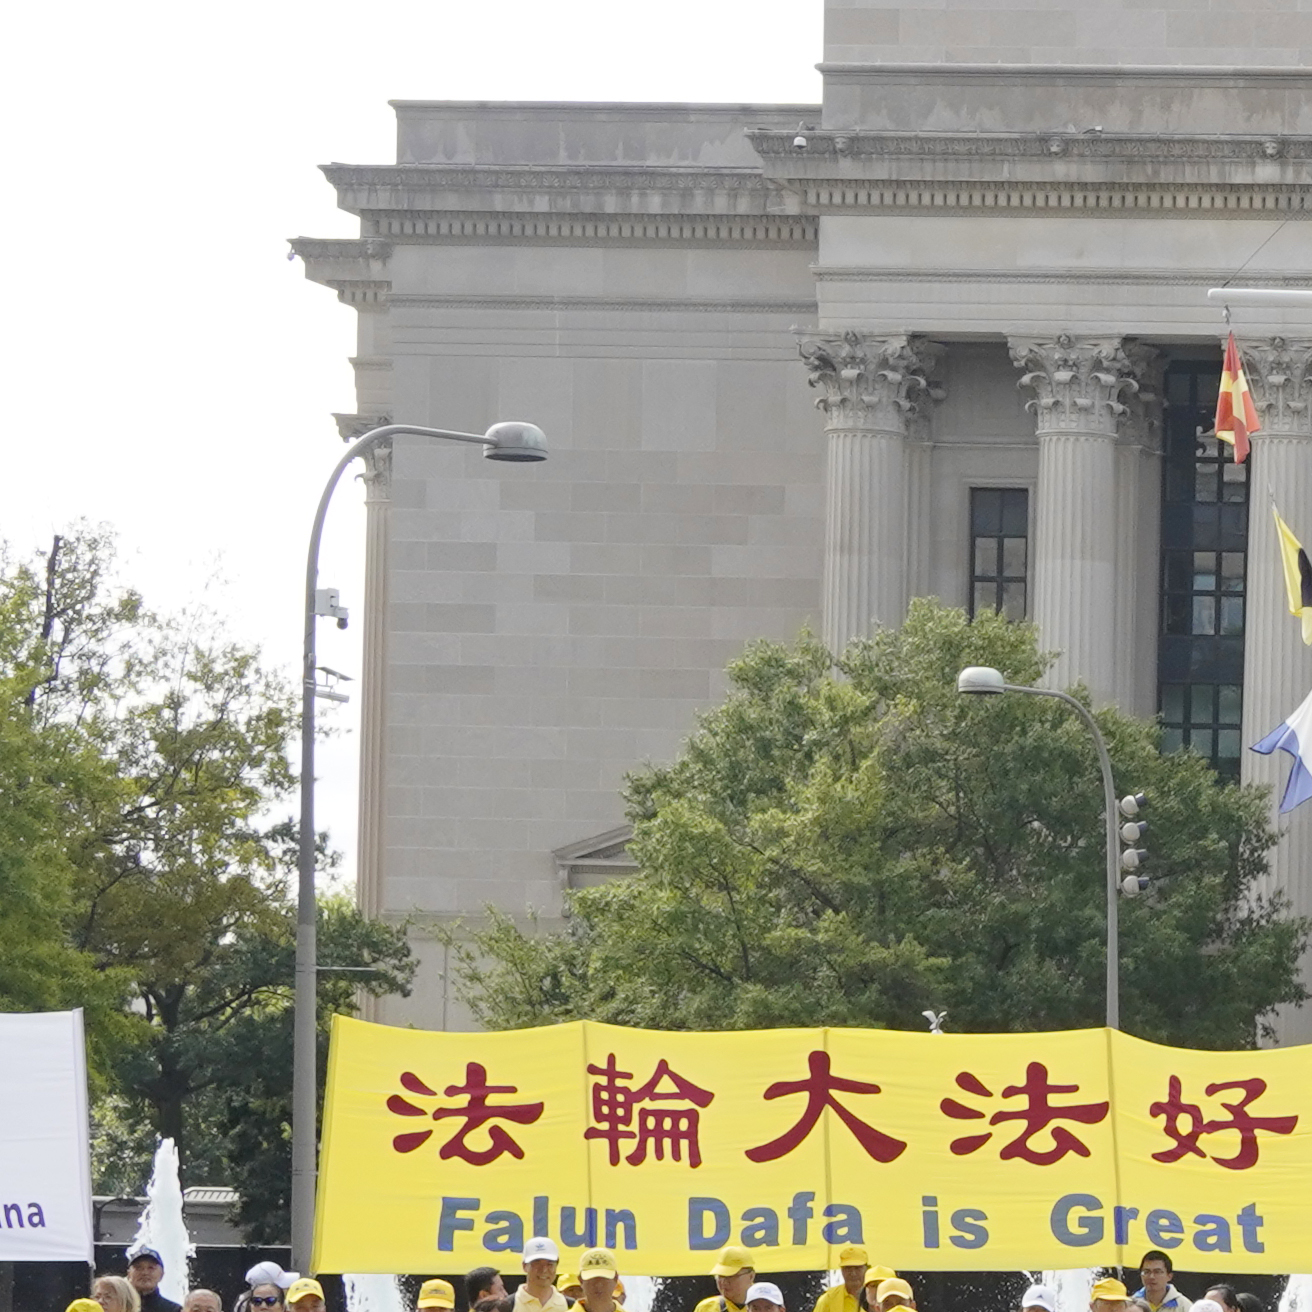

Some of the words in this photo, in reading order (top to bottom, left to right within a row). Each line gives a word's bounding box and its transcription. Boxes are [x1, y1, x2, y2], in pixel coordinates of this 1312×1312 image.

[386, 1049, 1300, 1171] 法輪大法好
[437, 1195, 639, 1254] Falun
[687, 1190, 865, 1252] Dafa
[921, 1195, 990, 1250] is
[1050, 1193, 1266, 1255] Great
